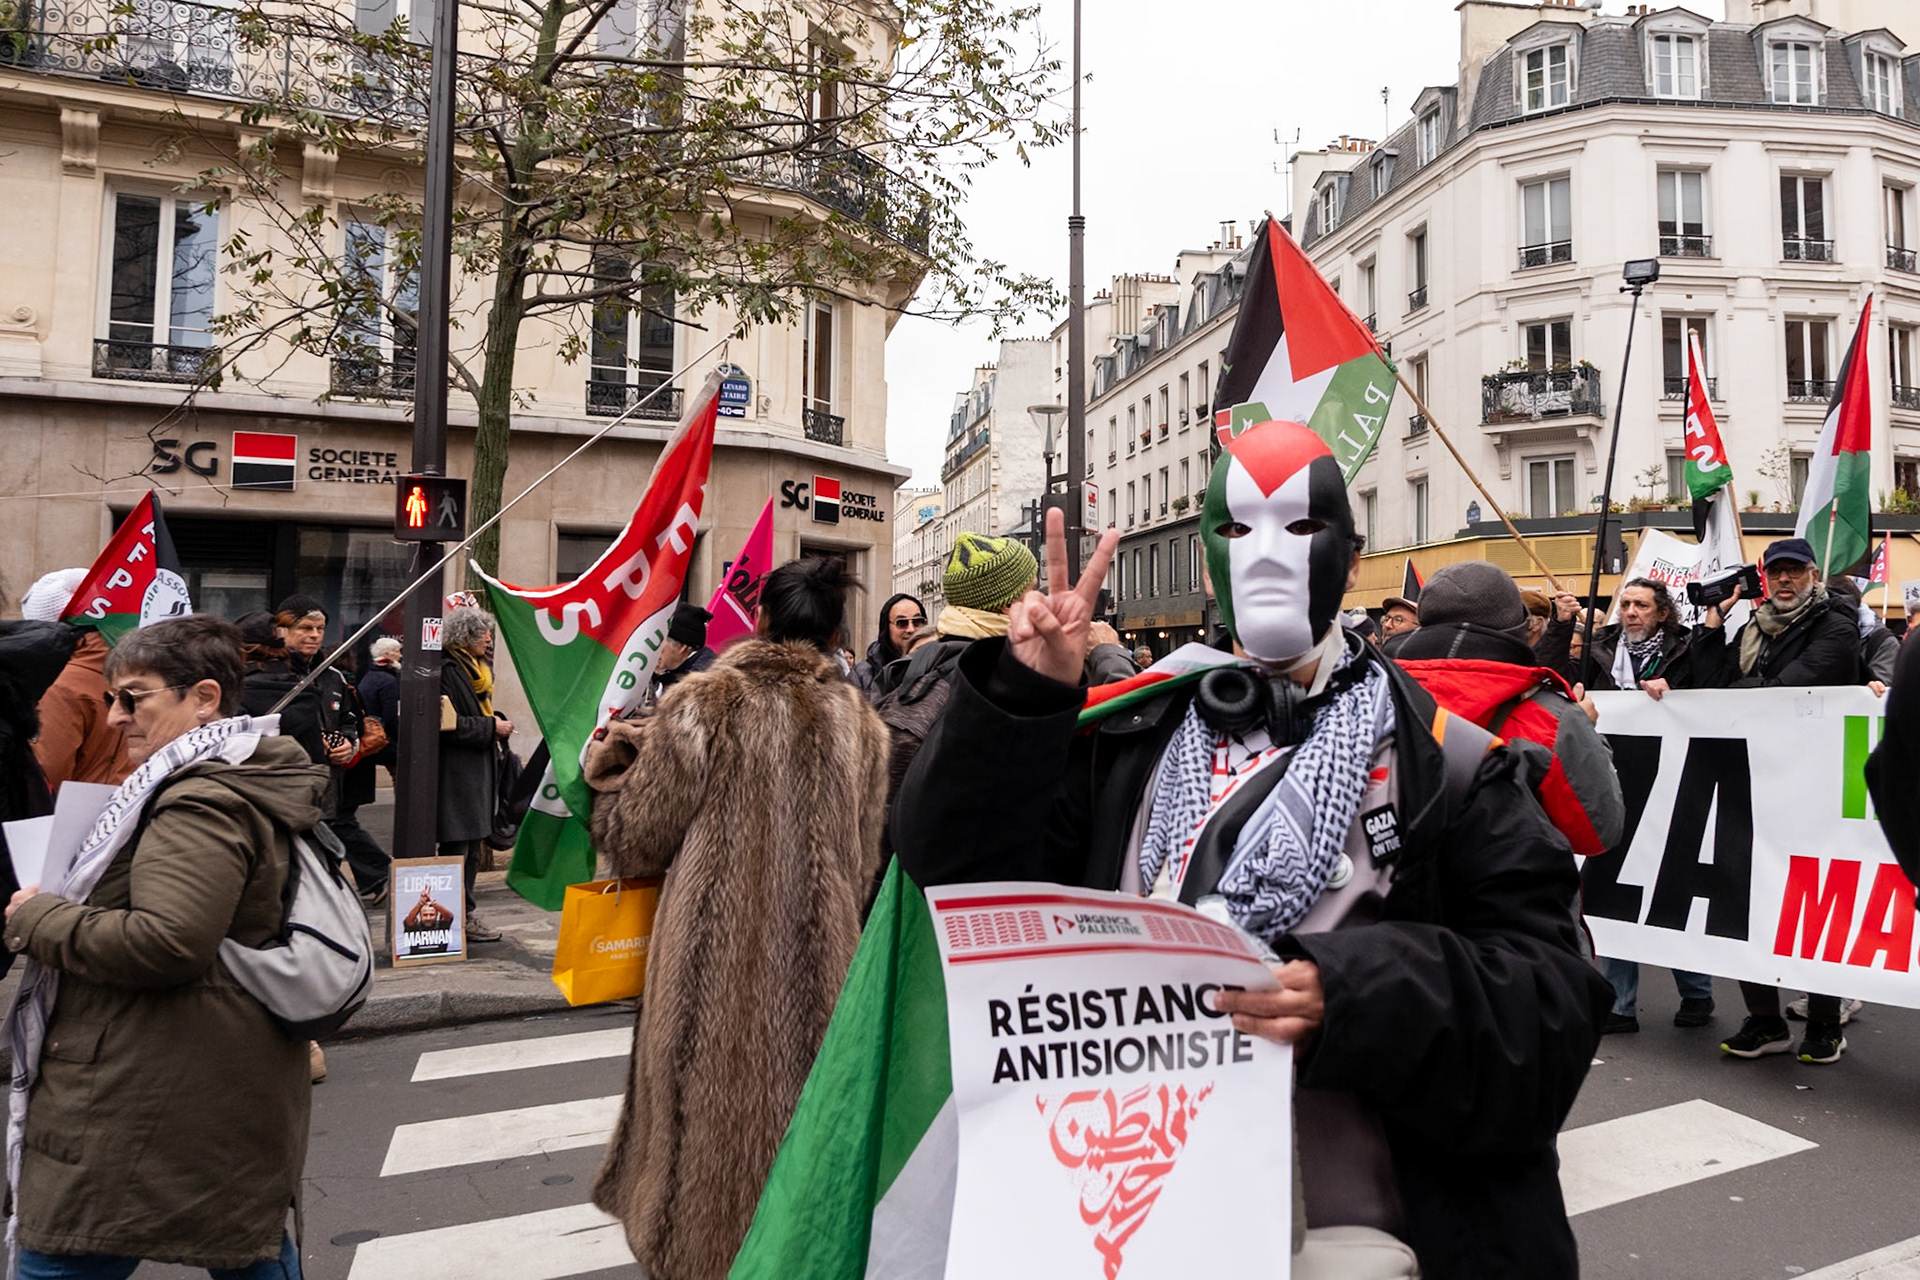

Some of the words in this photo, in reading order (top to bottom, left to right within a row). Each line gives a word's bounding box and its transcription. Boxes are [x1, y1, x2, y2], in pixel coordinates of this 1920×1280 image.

[721, 392, 747, 400] TAIRE
[723, 383, 747, 391] LEVARD
[153, 439, 218, 476] SG
[309, 448, 397, 467] SOCIETE
[781, 480, 809, 511] SG
[842, 491, 876, 507] SOCIETE
[842, 505, 885, 522] GENERALE
[534, 484, 707, 646] FPS
[1366, 811, 1397, 835] GAZA
[404, 872, 453, 893] LIBÉREZ
[1075, 914, 1132, 925] URGENCE
[1773, 855, 1920, 973] MA
[404, 929, 453, 947] MARWAN
[1079, 924, 1142, 935] PALESTINE
[992, 1029, 1254, 1084] ANTISIONISTE
